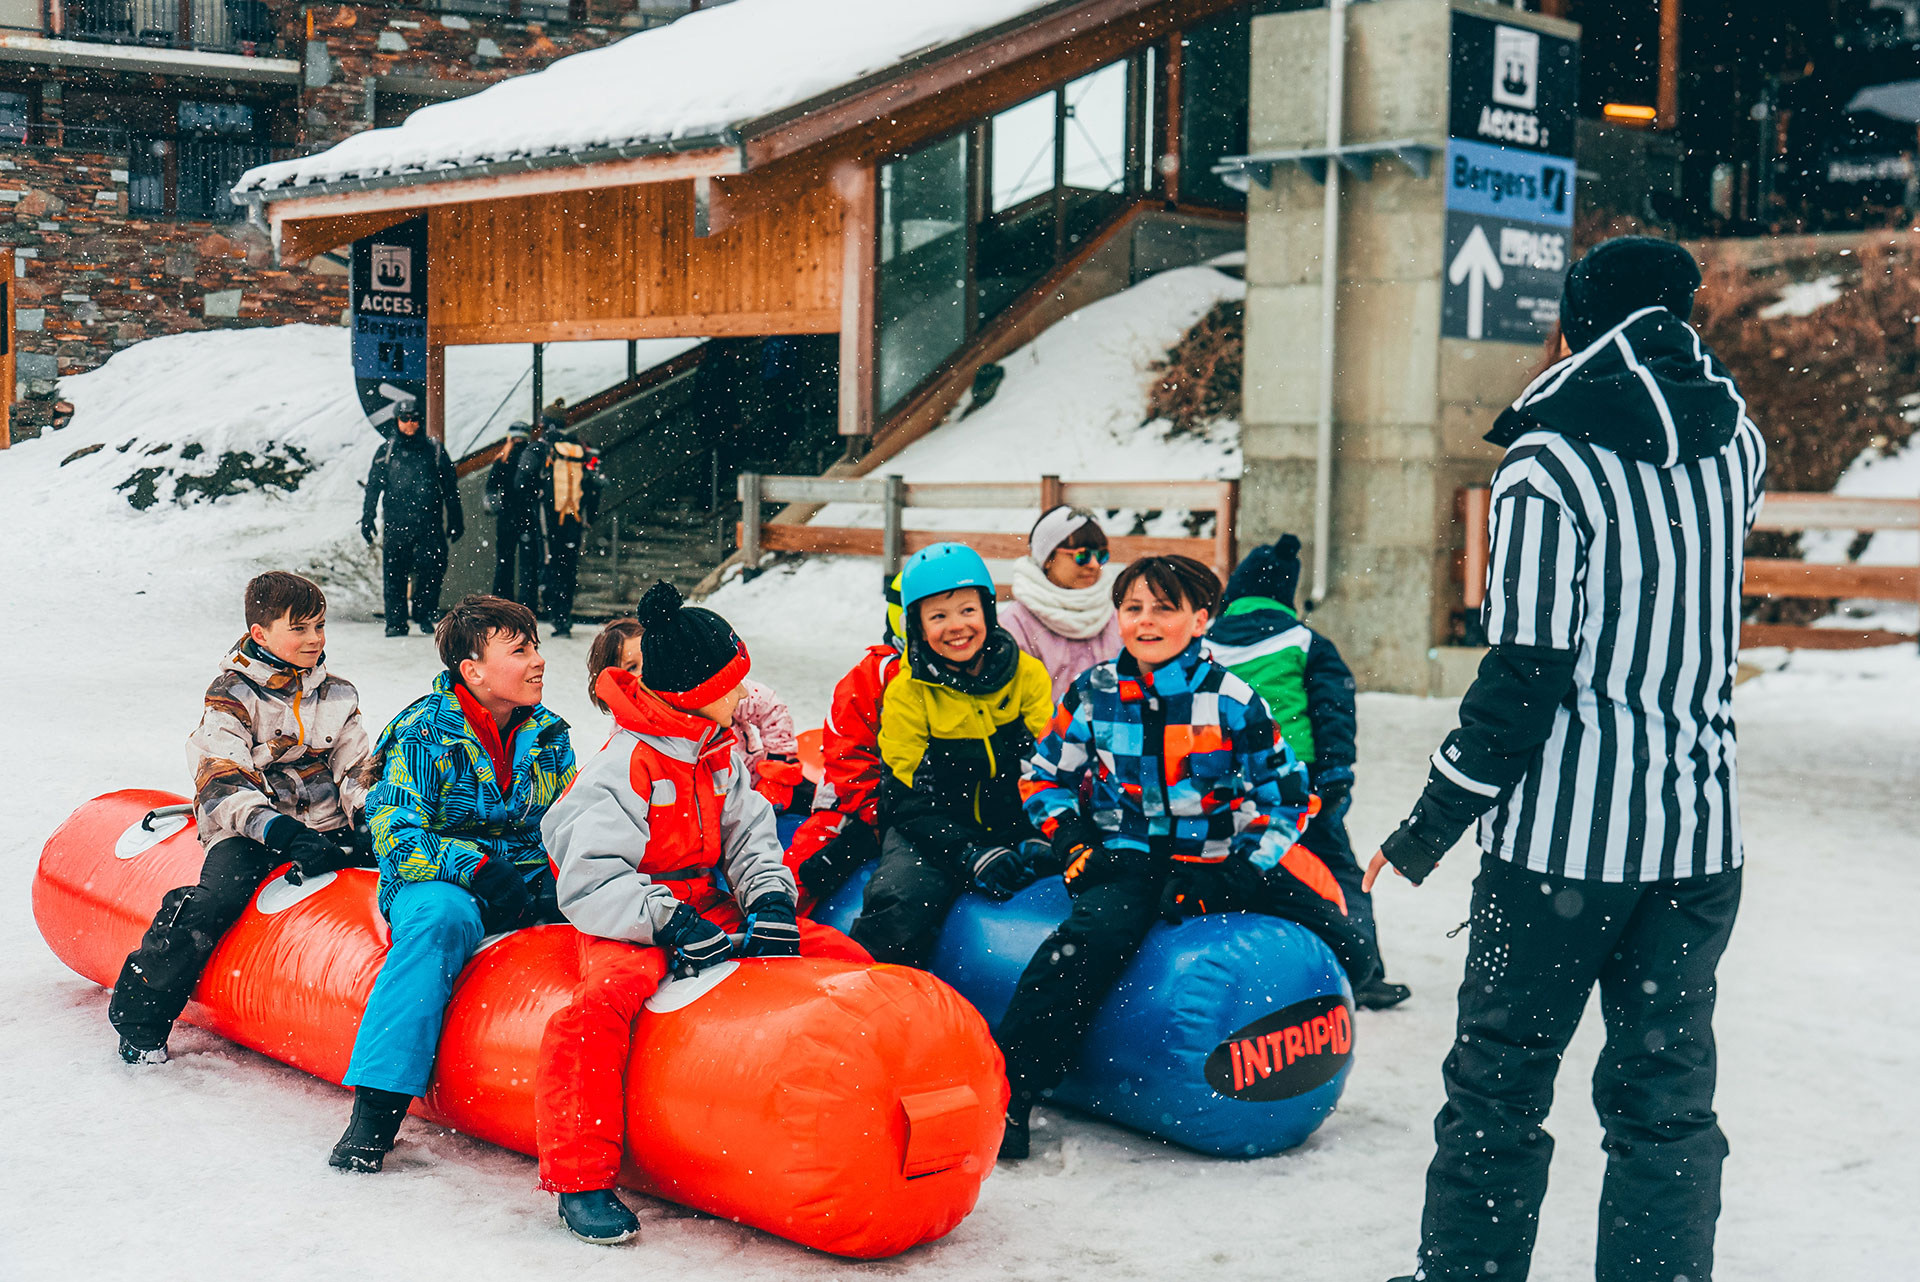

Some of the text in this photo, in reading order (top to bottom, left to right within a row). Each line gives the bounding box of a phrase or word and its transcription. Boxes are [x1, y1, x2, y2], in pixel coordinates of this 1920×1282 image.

[1477, 106, 1540, 146] ACCES
[1453, 154, 1538, 203] Bergers
[360, 294, 414, 314] ACCES
[357, 317, 425, 341] Bergers
[1229, 1004, 1352, 1092] INTRIPID
